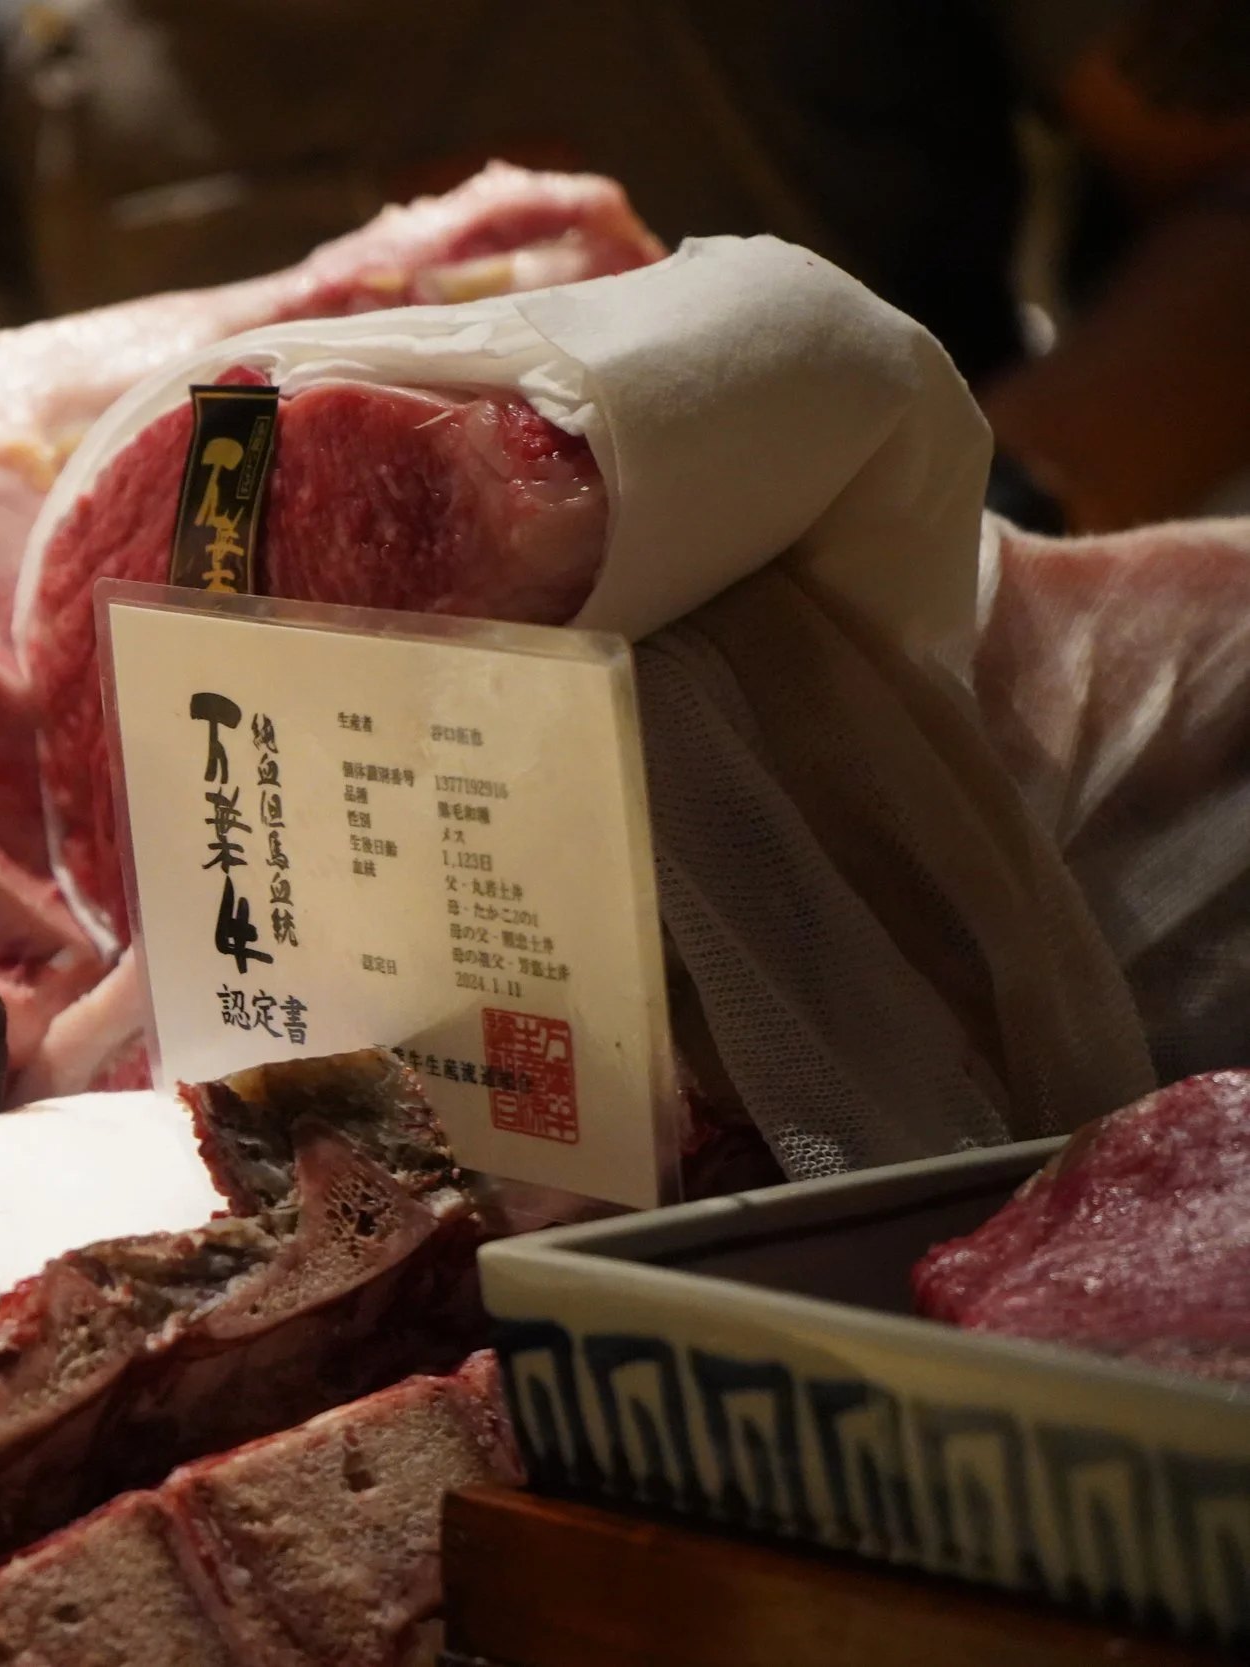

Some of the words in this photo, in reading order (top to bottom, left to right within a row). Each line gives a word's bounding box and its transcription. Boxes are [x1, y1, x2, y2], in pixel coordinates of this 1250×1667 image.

[338, 711, 373, 733] 生産者
[190, 692, 274, 974] 万葉牛
[251, 712, 299, 947] 純血但馬血統
[217, 983, 308, 1044] 認定書
